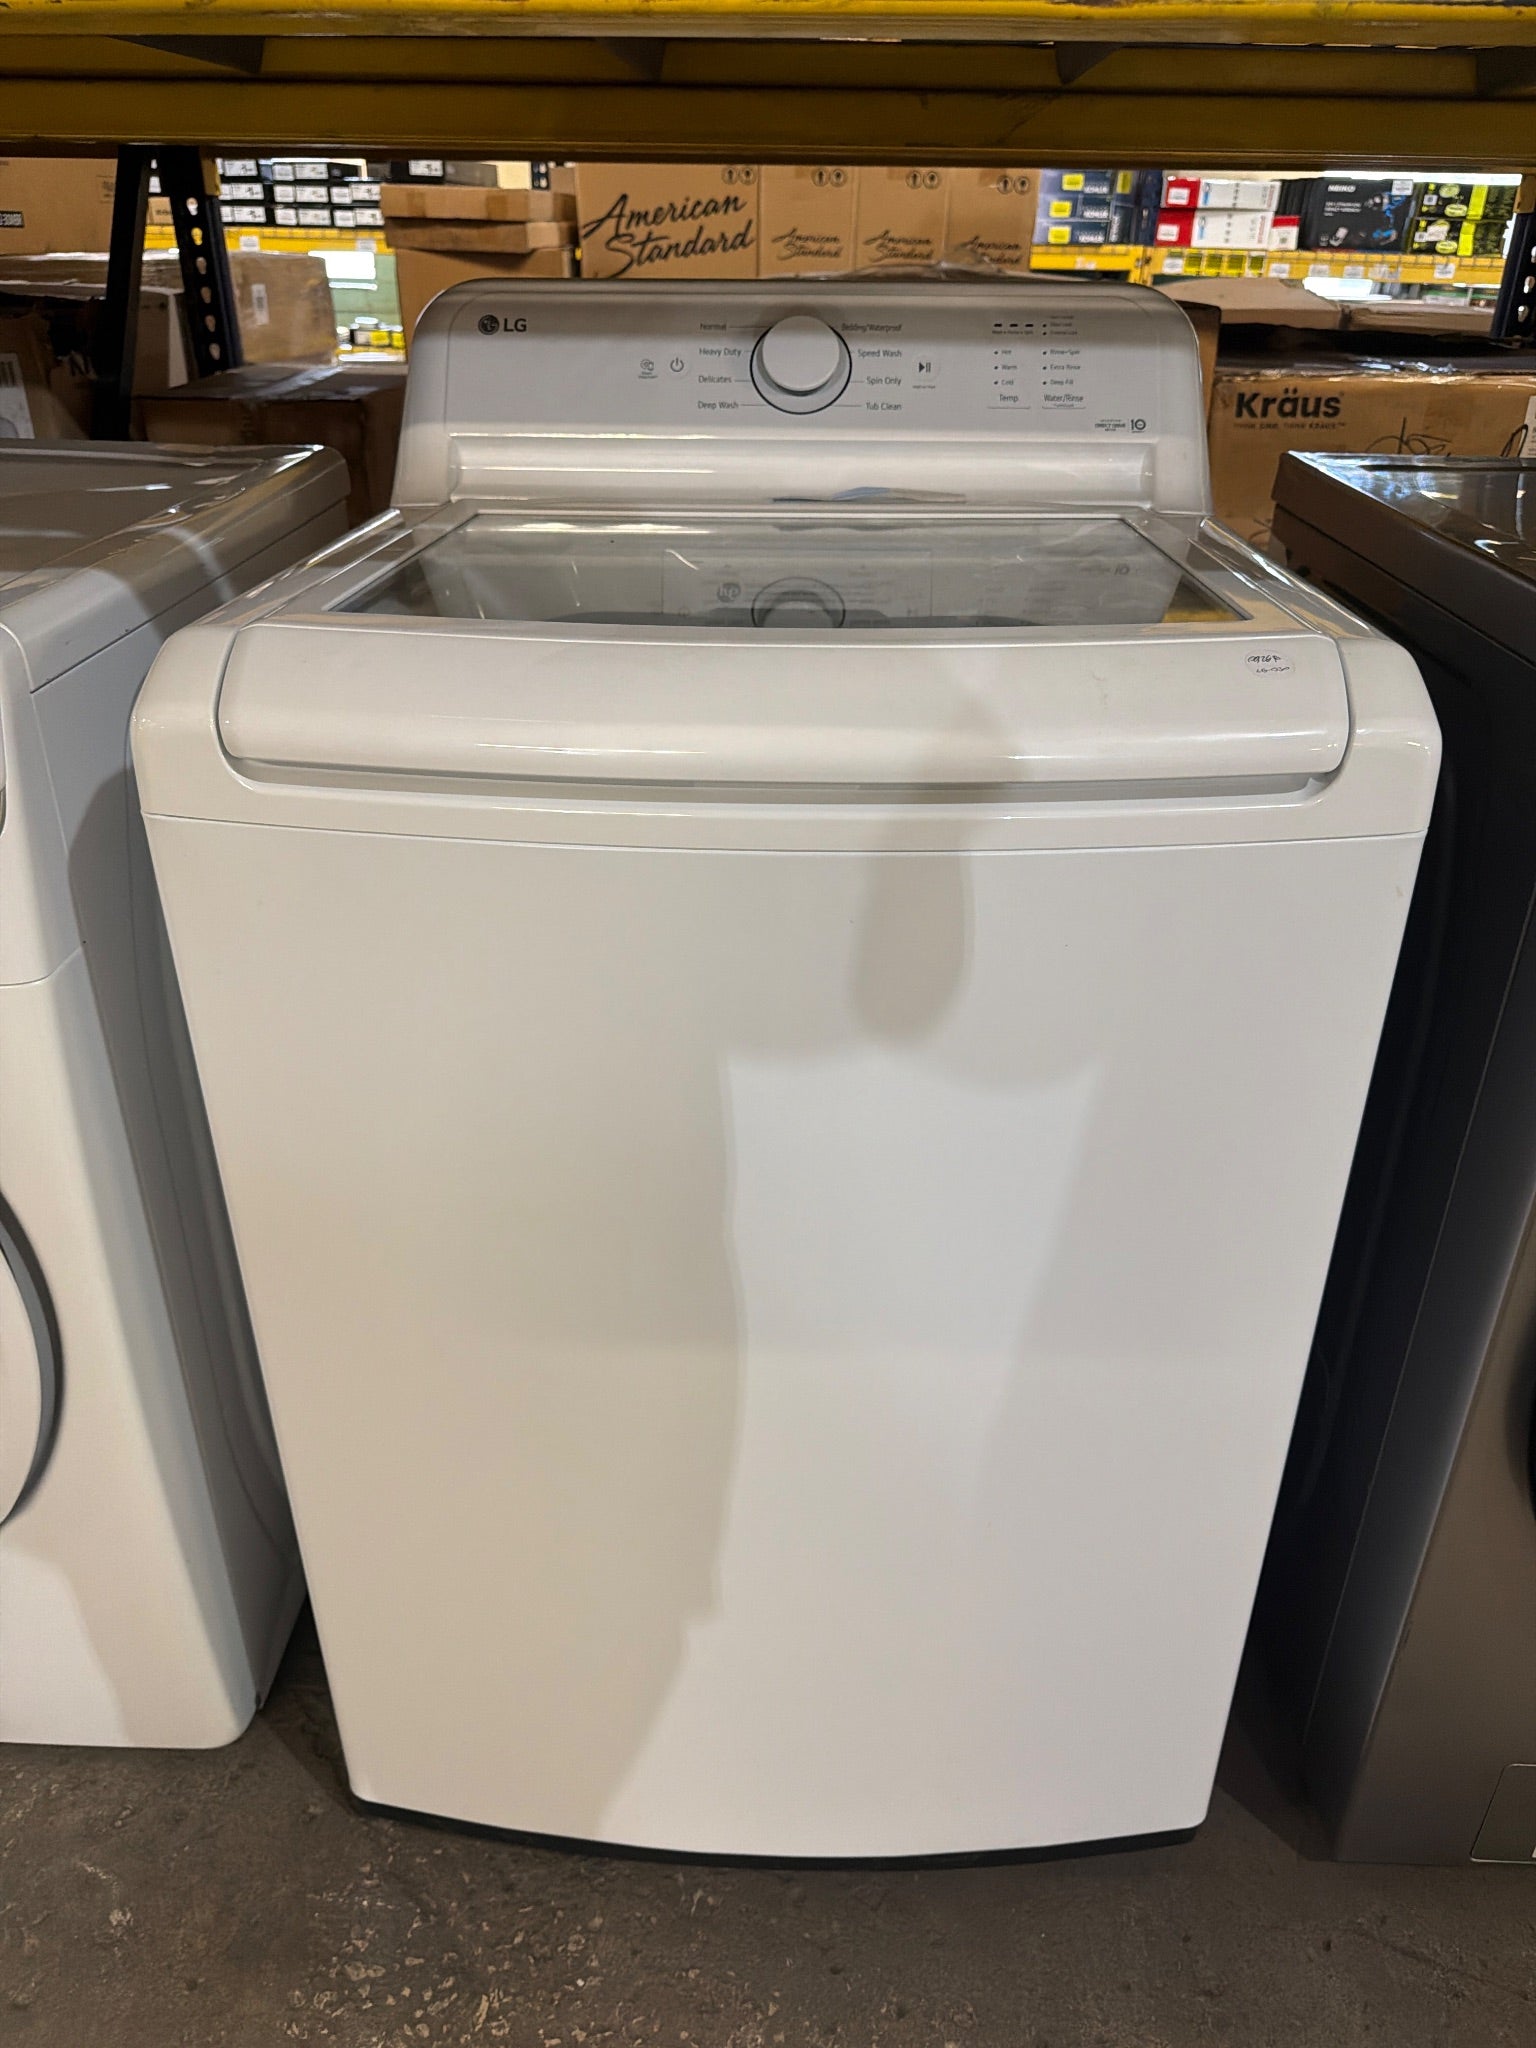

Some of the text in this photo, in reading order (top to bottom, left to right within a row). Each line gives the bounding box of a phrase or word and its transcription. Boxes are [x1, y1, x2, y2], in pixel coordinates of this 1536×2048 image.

[581, 193, 748, 239] American
[771, 228, 840, 246] American
[864, 229, 932, 246] American
[604, 219, 756, 278] Standard
[777, 243, 842, 261] Standard
[867, 244, 933, 263] Standard
[503, 317, 527, 332] LG
[700, 323, 727, 331] Normal
[699, 348, 741, 358] Heavy Duty
[857, 348, 902, 359] Speed Wash
[698, 375, 732, 384] Delicates
[867, 377, 902, 387] Spin Only
[999, 394, 1019, 403] Temp
[1044, 394, 1083, 403] Water/Rinse
[1235, 387, 1342, 418] Kräus
[698, 401, 738, 411] Deep Wash
[866, 402, 902, 410] Tub Clean
